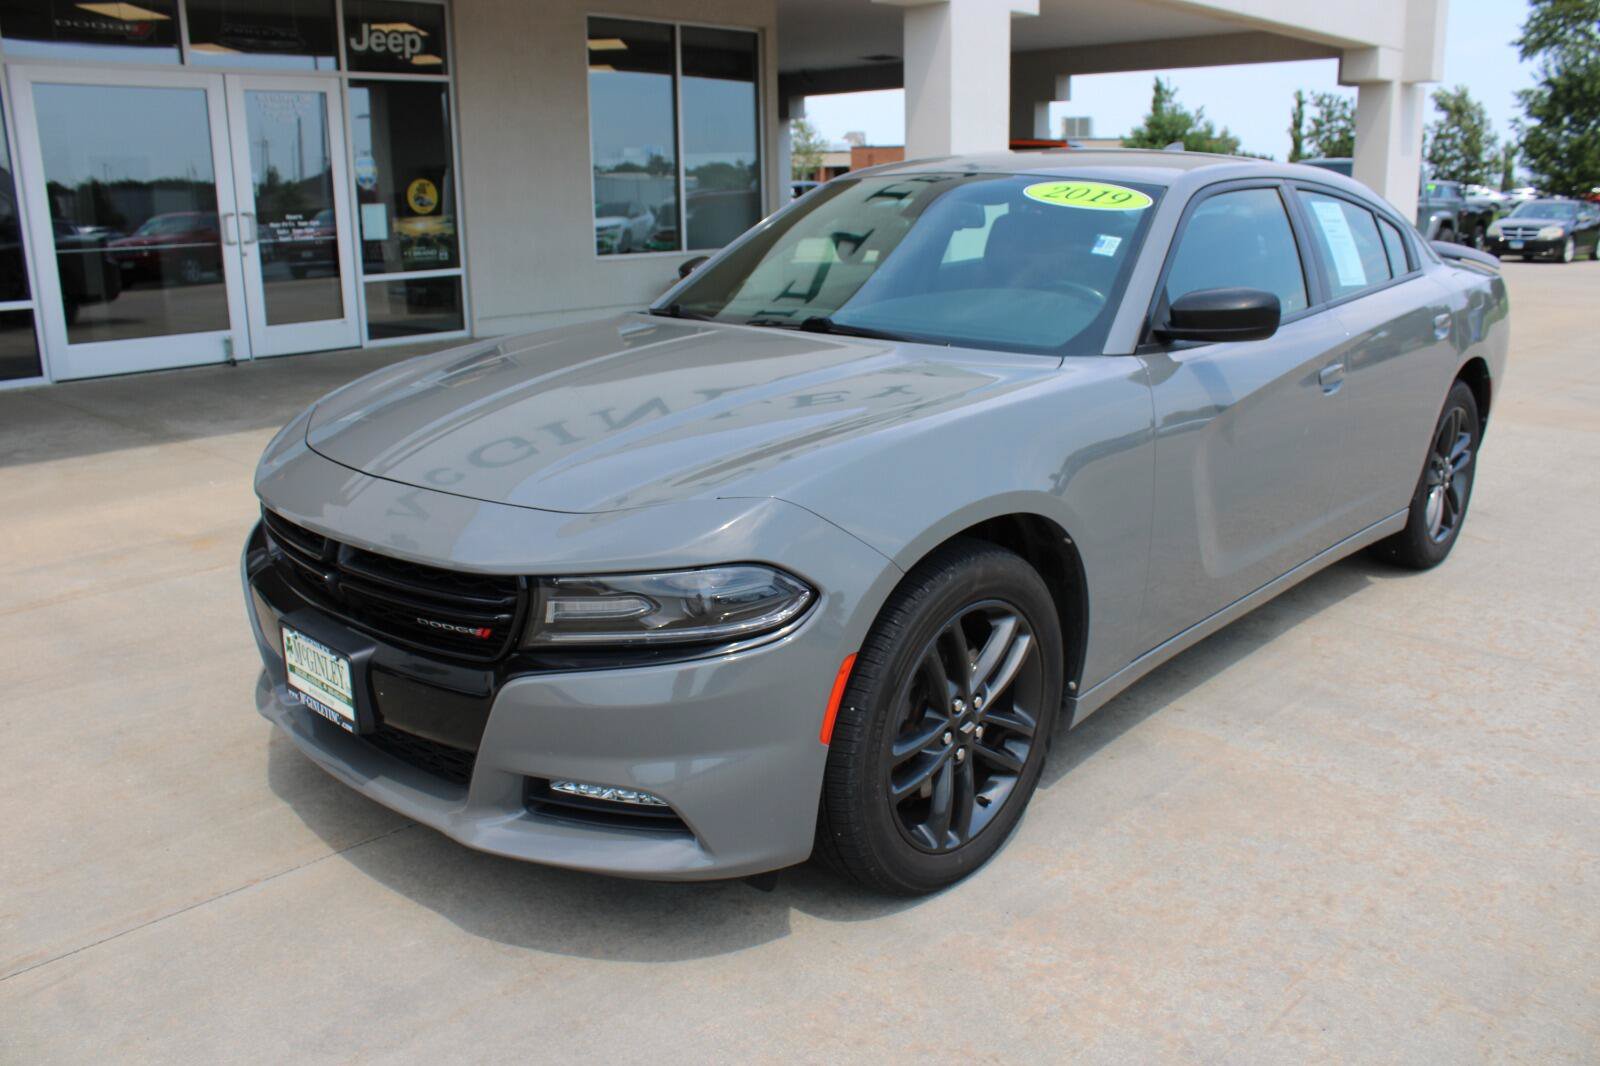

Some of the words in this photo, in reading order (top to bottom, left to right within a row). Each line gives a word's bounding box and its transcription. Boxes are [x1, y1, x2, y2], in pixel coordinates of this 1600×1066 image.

[350, 23, 421, 59] Jeep
[1043, 186, 1132, 204] 2019
[416, 617, 476, 635] DODGE
